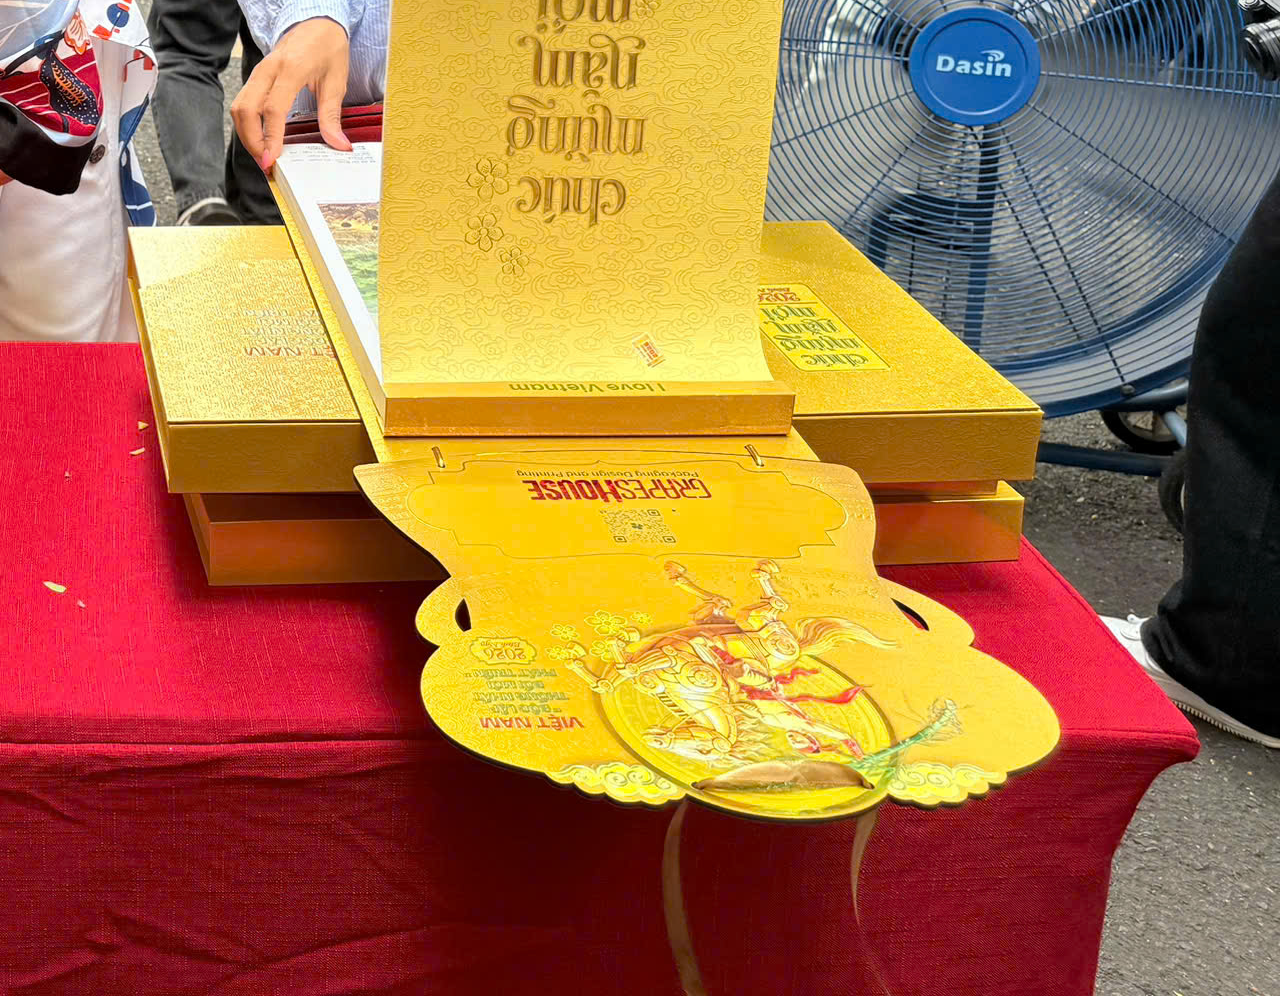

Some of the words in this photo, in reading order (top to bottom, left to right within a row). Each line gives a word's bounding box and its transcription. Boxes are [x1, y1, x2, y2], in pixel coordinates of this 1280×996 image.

[518, 33, 648, 100] năm
[935, 51, 1012, 78] Dasin
[506, 94, 650, 163] mừng
[515, 174, 627, 228] chúc
[244, 347, 302, 357] NAM
[508, 383, 605, 393] Vietnam
[606, 383, 655, 392] love
[657, 383, 666, 392] I
[516, 470, 564, 479] Printing
[594, 470, 634, 479] Design
[635, 470, 700, 479] Packaging
[522, 478, 713, 504] GRAPESHOUSE
[483, 647, 528, 661] 2026
[478, 716, 533, 729] NAM
[537, 713, 585, 731] VIỆT
